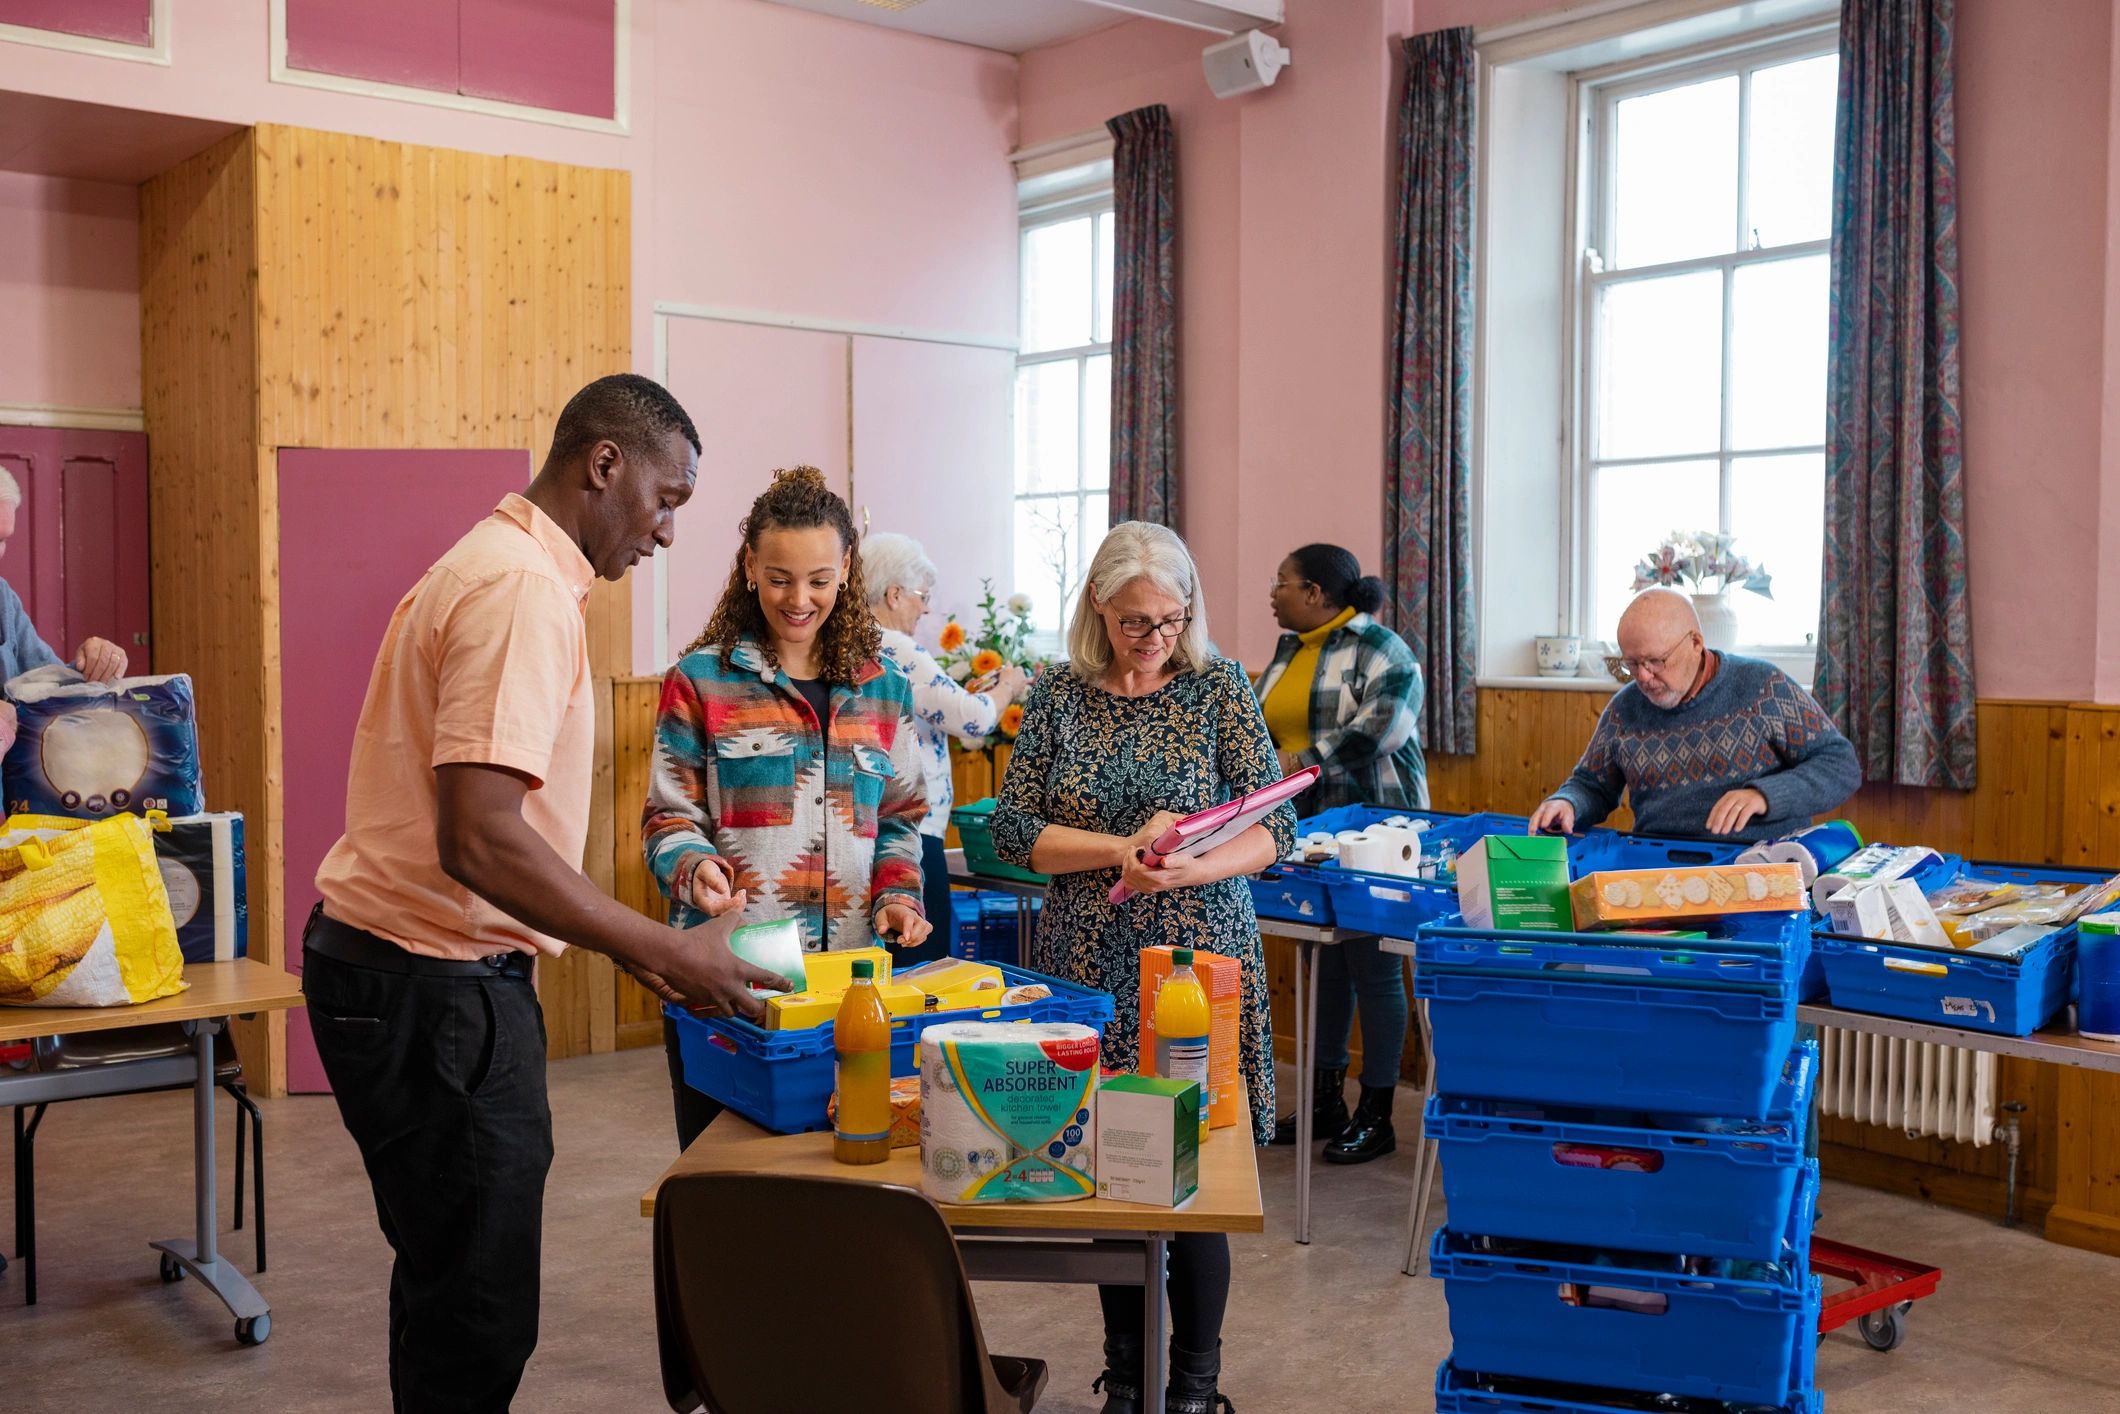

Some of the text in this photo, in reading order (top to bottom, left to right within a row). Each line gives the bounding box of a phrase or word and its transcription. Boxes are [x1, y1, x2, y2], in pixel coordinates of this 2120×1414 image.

[9, 800, 30, 814] 24
[1005, 1060, 1056, 1076] SUPER
[983, 1075, 1077, 1092] ABSORBENT
[1007, 1094, 1055, 1104] decorated
[1000, 1103, 1061, 1113] kitchen towel
[1065, 1128, 1081, 1137] 100
